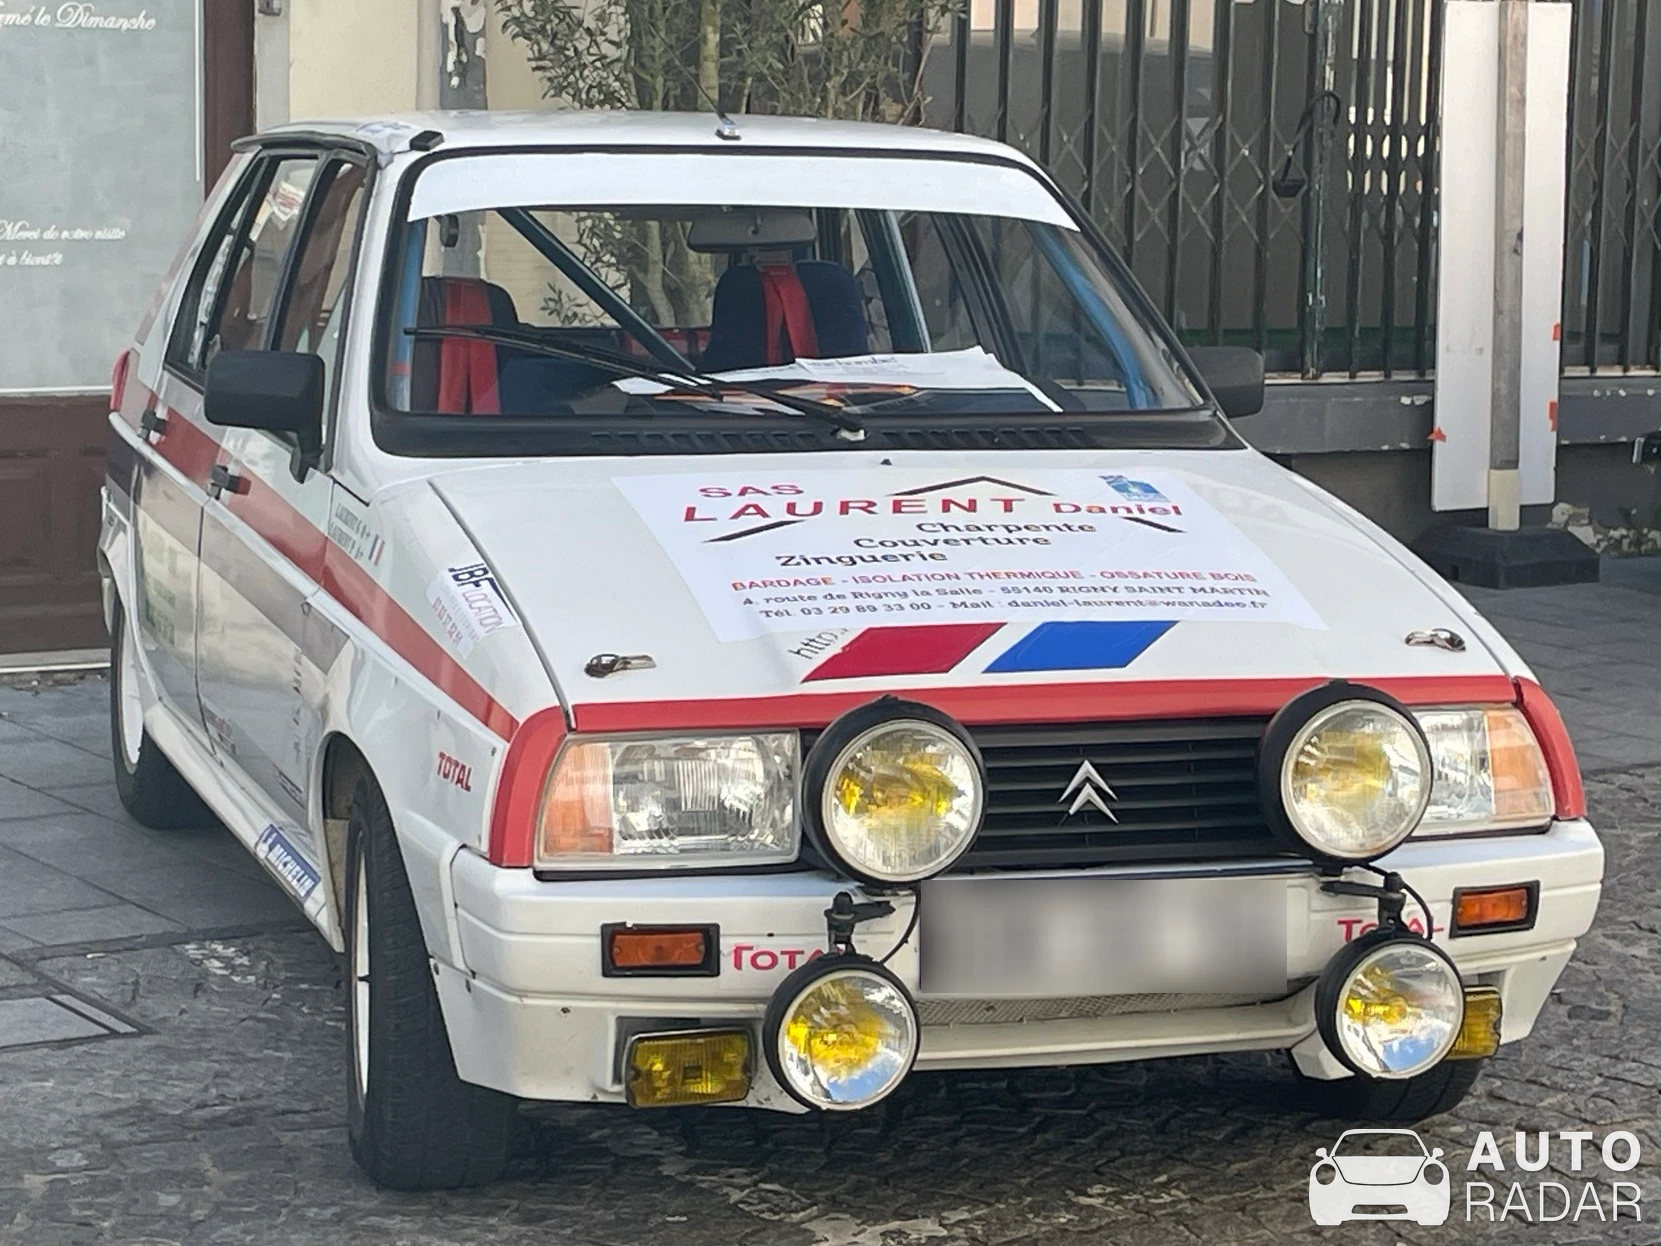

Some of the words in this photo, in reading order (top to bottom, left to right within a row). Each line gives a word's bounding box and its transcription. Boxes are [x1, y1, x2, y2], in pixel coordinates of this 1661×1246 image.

[34, 6, 50, 26] le
[55, 1, 156, 32] Dimanche
[0, 220, 40, 240] Merci
[43, 225, 60, 240] de
[699, 484, 805, 498] SAS
[684, 498, 1026, 522] LAURENT
[1053, 502, 1183, 516] Daniel
[916, 521, 1097, 534] Charpente
[853, 534, 1052, 549] Couverture
[775, 550, 948, 567] Zinguerie
[447, 562, 493, 588] JBF
[731, 576, 836, 592] BARDAGE
[851, 571, 961, 585] ISOLATION
[964, 569, 1084, 581] THERMIQUE
[1099, 570, 1207, 581] OSSATURE
[1208, 571, 1258, 583] BOIS
[763, 593, 818, 604] route
[822, 592, 848, 602] de
[849, 589, 910, 600] Rigny
[911, 588, 932, 597] la
[934, 587, 984, 597] Salle
[1055, 585, 1119, 595] RIGNY
[1123, 585, 1186, 595] SAINT
[1188, 585, 1271, 598] MARTIN
[462, 587, 506, 634] LOCATION
[800, 606, 824, 616] 03
[827, 605, 851, 615] 29
[881, 603, 905, 612] 33
[909, 602, 932, 611] 00
[949, 600, 994, 610] Mail
[437, 751, 472, 792] TOTAL
[266, 843, 316, 896] MICHELIN
[732, 945, 845, 971] TOT
